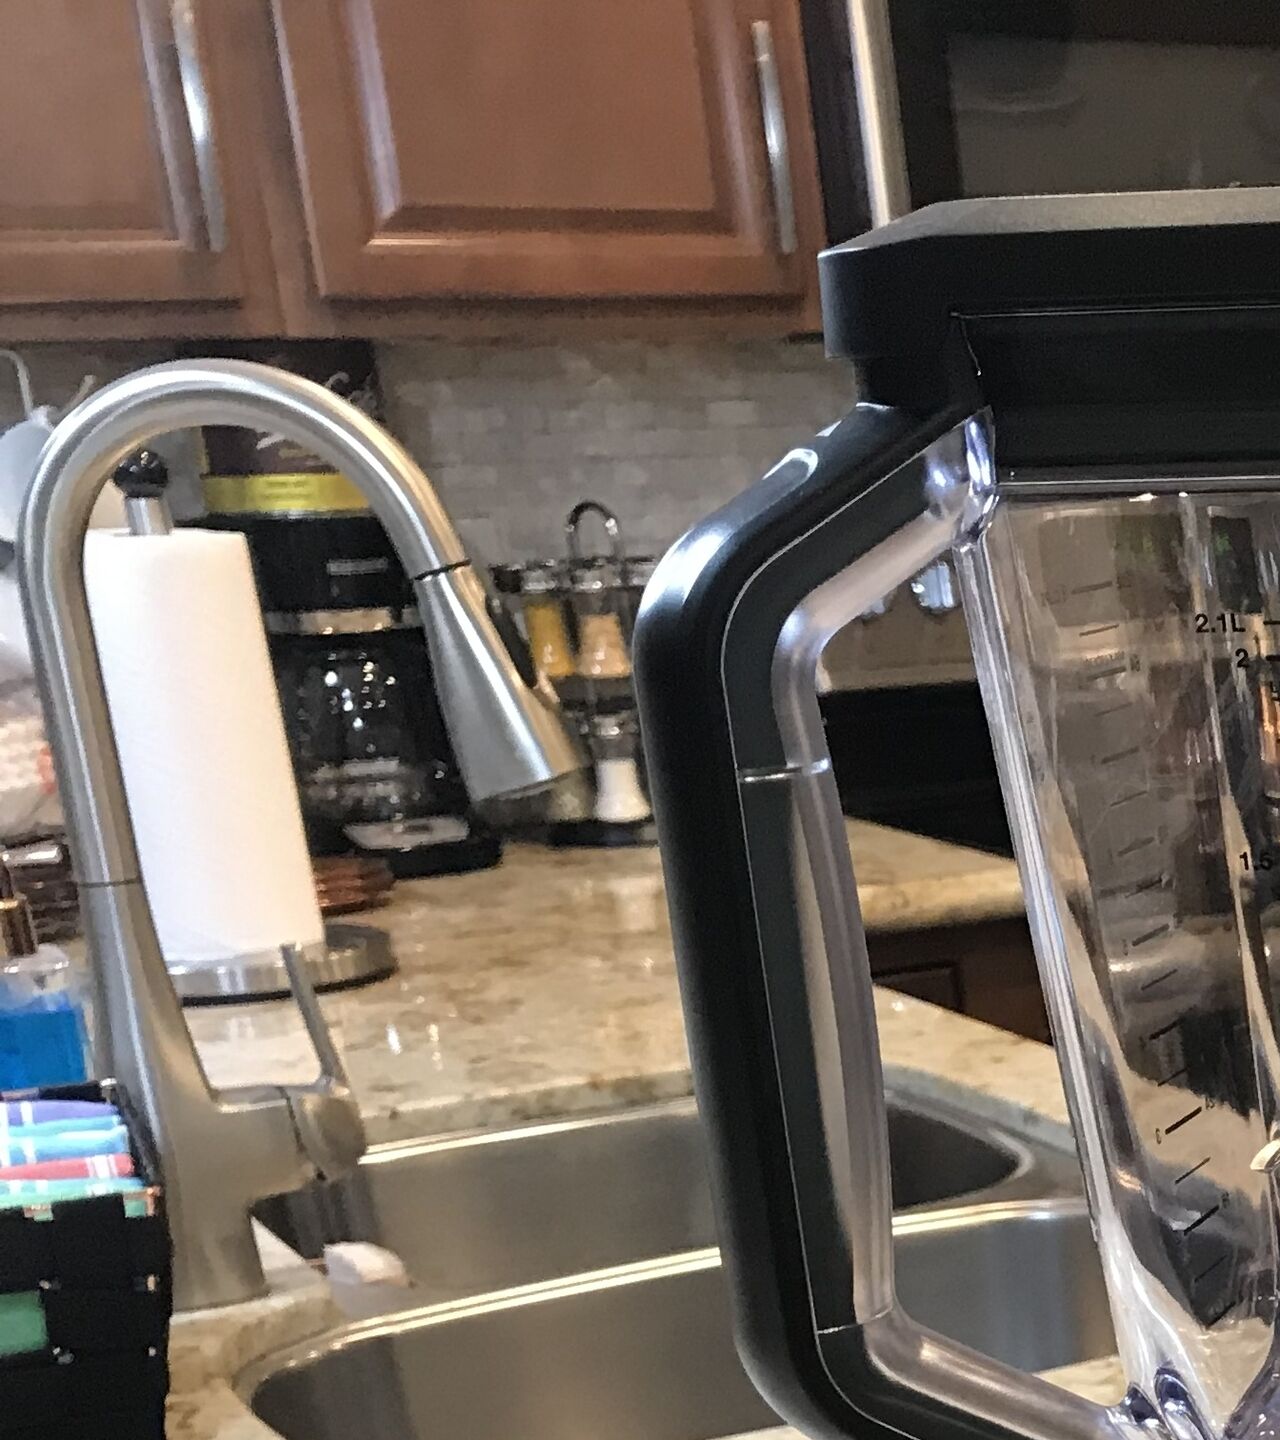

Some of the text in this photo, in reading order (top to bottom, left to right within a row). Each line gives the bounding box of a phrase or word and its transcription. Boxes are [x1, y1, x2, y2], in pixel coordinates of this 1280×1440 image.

[1195, 613, 1246, 633] 2.1L
[1235, 648, 1249, 668] 2
[1239, 851, 1273, 870] 1.5
